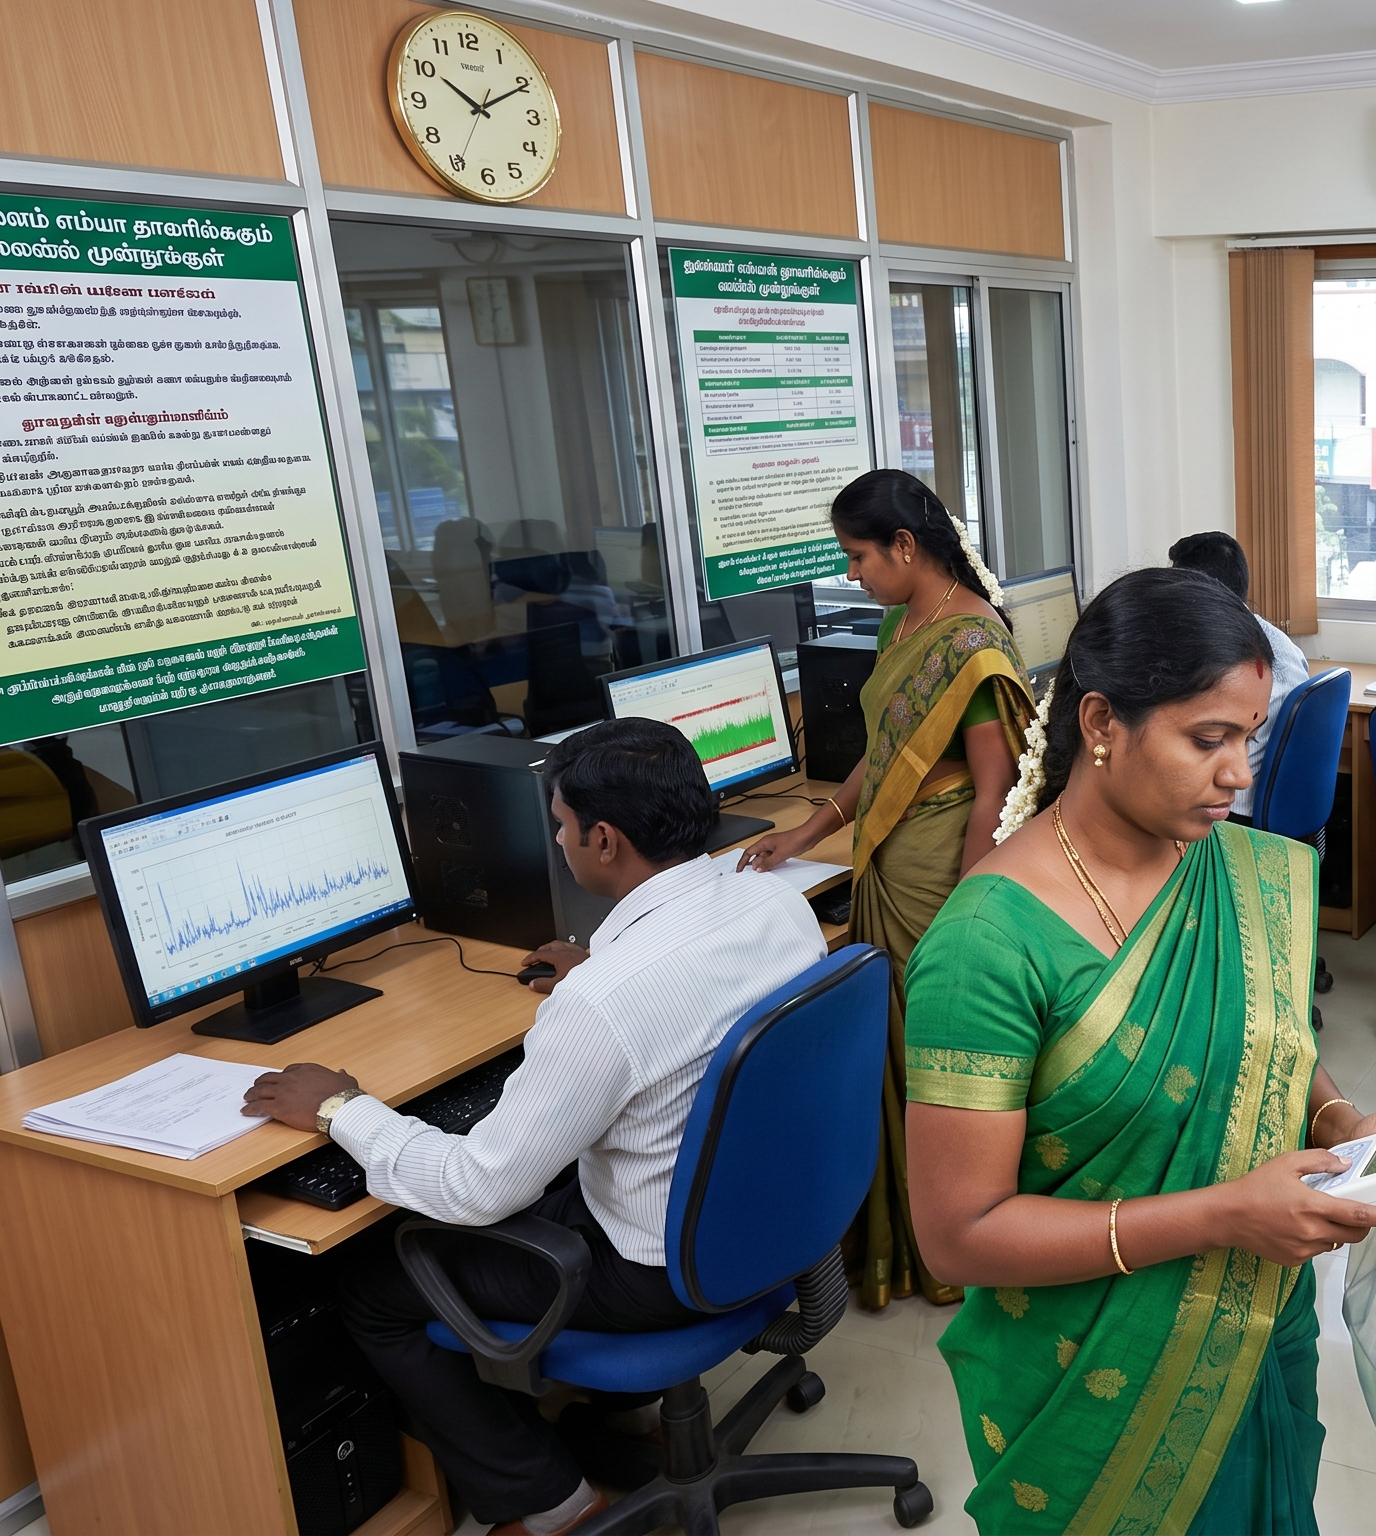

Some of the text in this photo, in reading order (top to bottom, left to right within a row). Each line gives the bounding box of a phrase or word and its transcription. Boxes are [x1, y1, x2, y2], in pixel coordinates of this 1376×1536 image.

[432, 38, 449, 56] 11
[457, 32, 479, 51] 12
[495, 48, 503, 65] 1
[413, 59, 436, 78] 10
[515, 76, 530, 94] 2
[410, 91, 427, 109] 9
[526, 109, 541, 126] 3
[425, 126, 441, 144] 8
[480, 167, 496, 186] 6
[507, 162, 523, 179] 5
